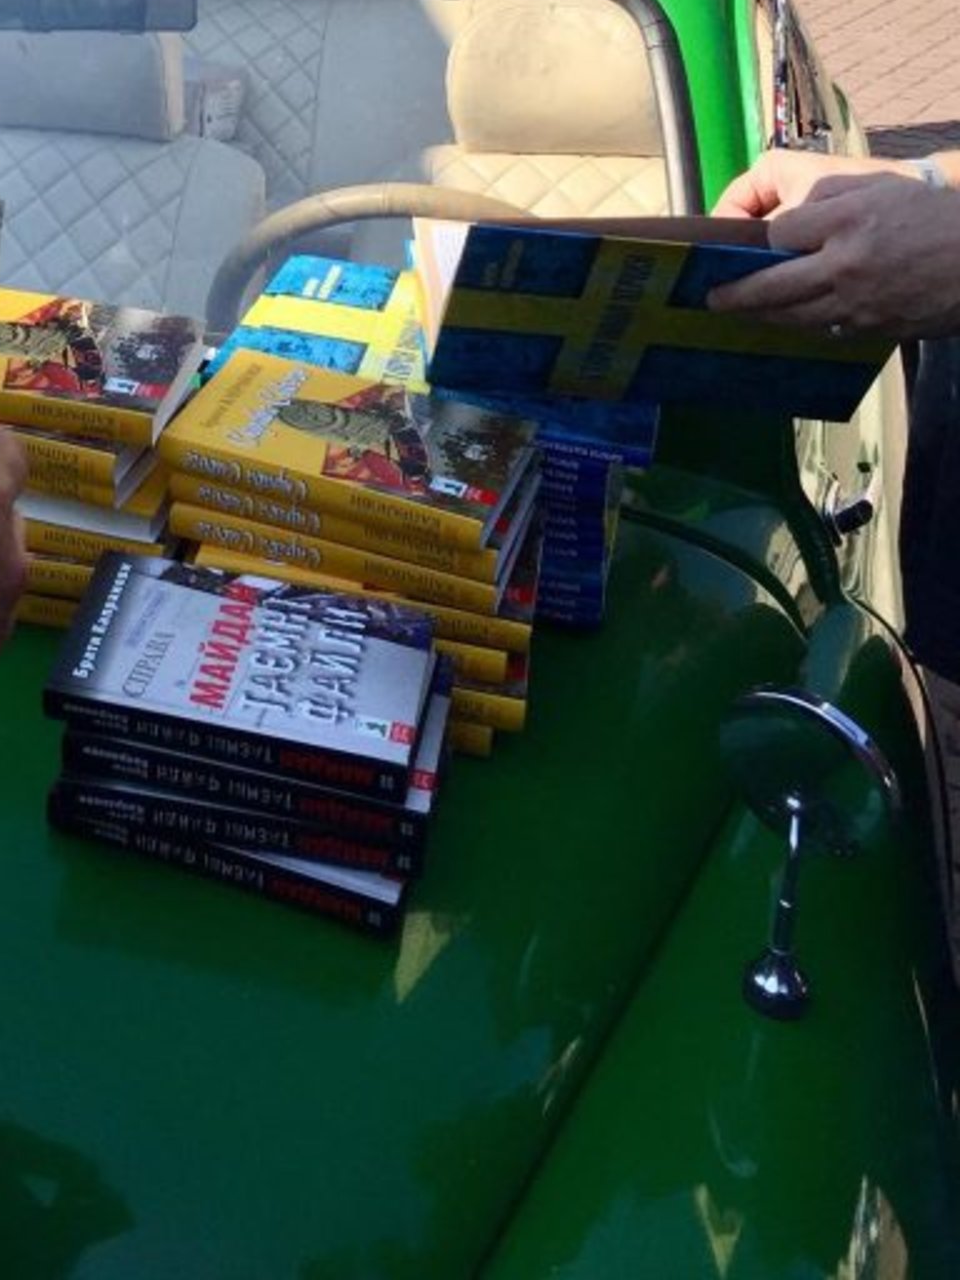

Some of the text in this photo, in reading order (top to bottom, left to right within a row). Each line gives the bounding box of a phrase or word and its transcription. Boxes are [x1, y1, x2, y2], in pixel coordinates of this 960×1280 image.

[122, 631, 176, 698] СПРАВА
[190, 581, 261, 710] МАЙДАН
[242, 596, 313, 713] ТАЄМНІ
[299, 605, 369, 723] ФАЙЛИ
